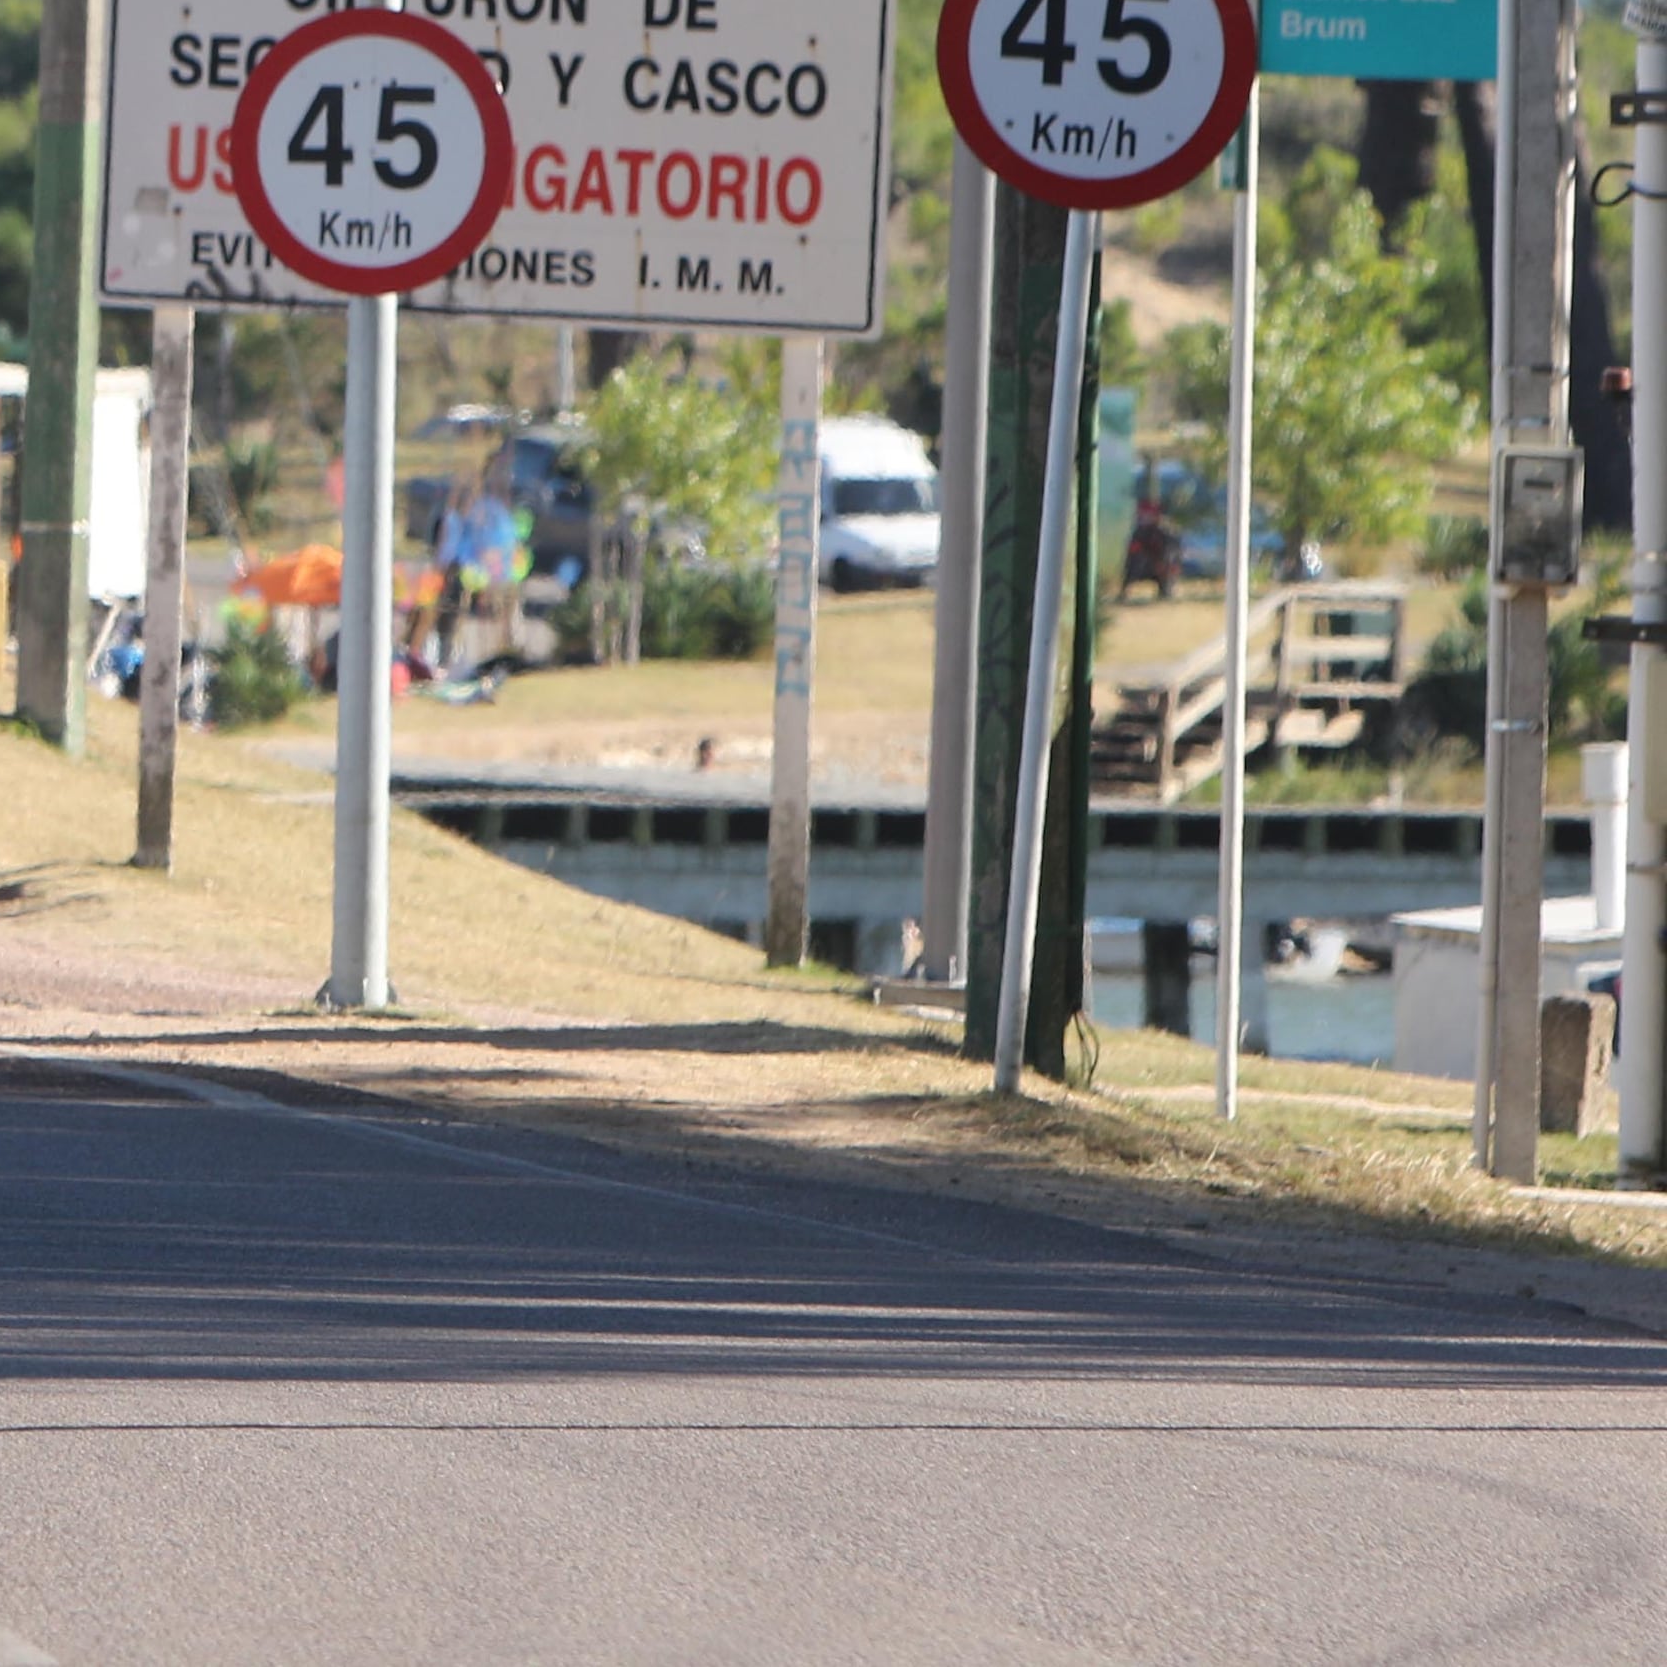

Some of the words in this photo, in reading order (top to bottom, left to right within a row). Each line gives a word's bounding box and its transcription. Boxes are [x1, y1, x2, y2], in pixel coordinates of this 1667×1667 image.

[1279, 8, 1367, 42] Brum
[549, 52, 586, 106] Y
[623, 56, 827, 119] CASCO
[286, 85, 439, 190] 45
[1030, 112, 1137, 162] Km/h
[318, 210, 412, 254] Km/h
